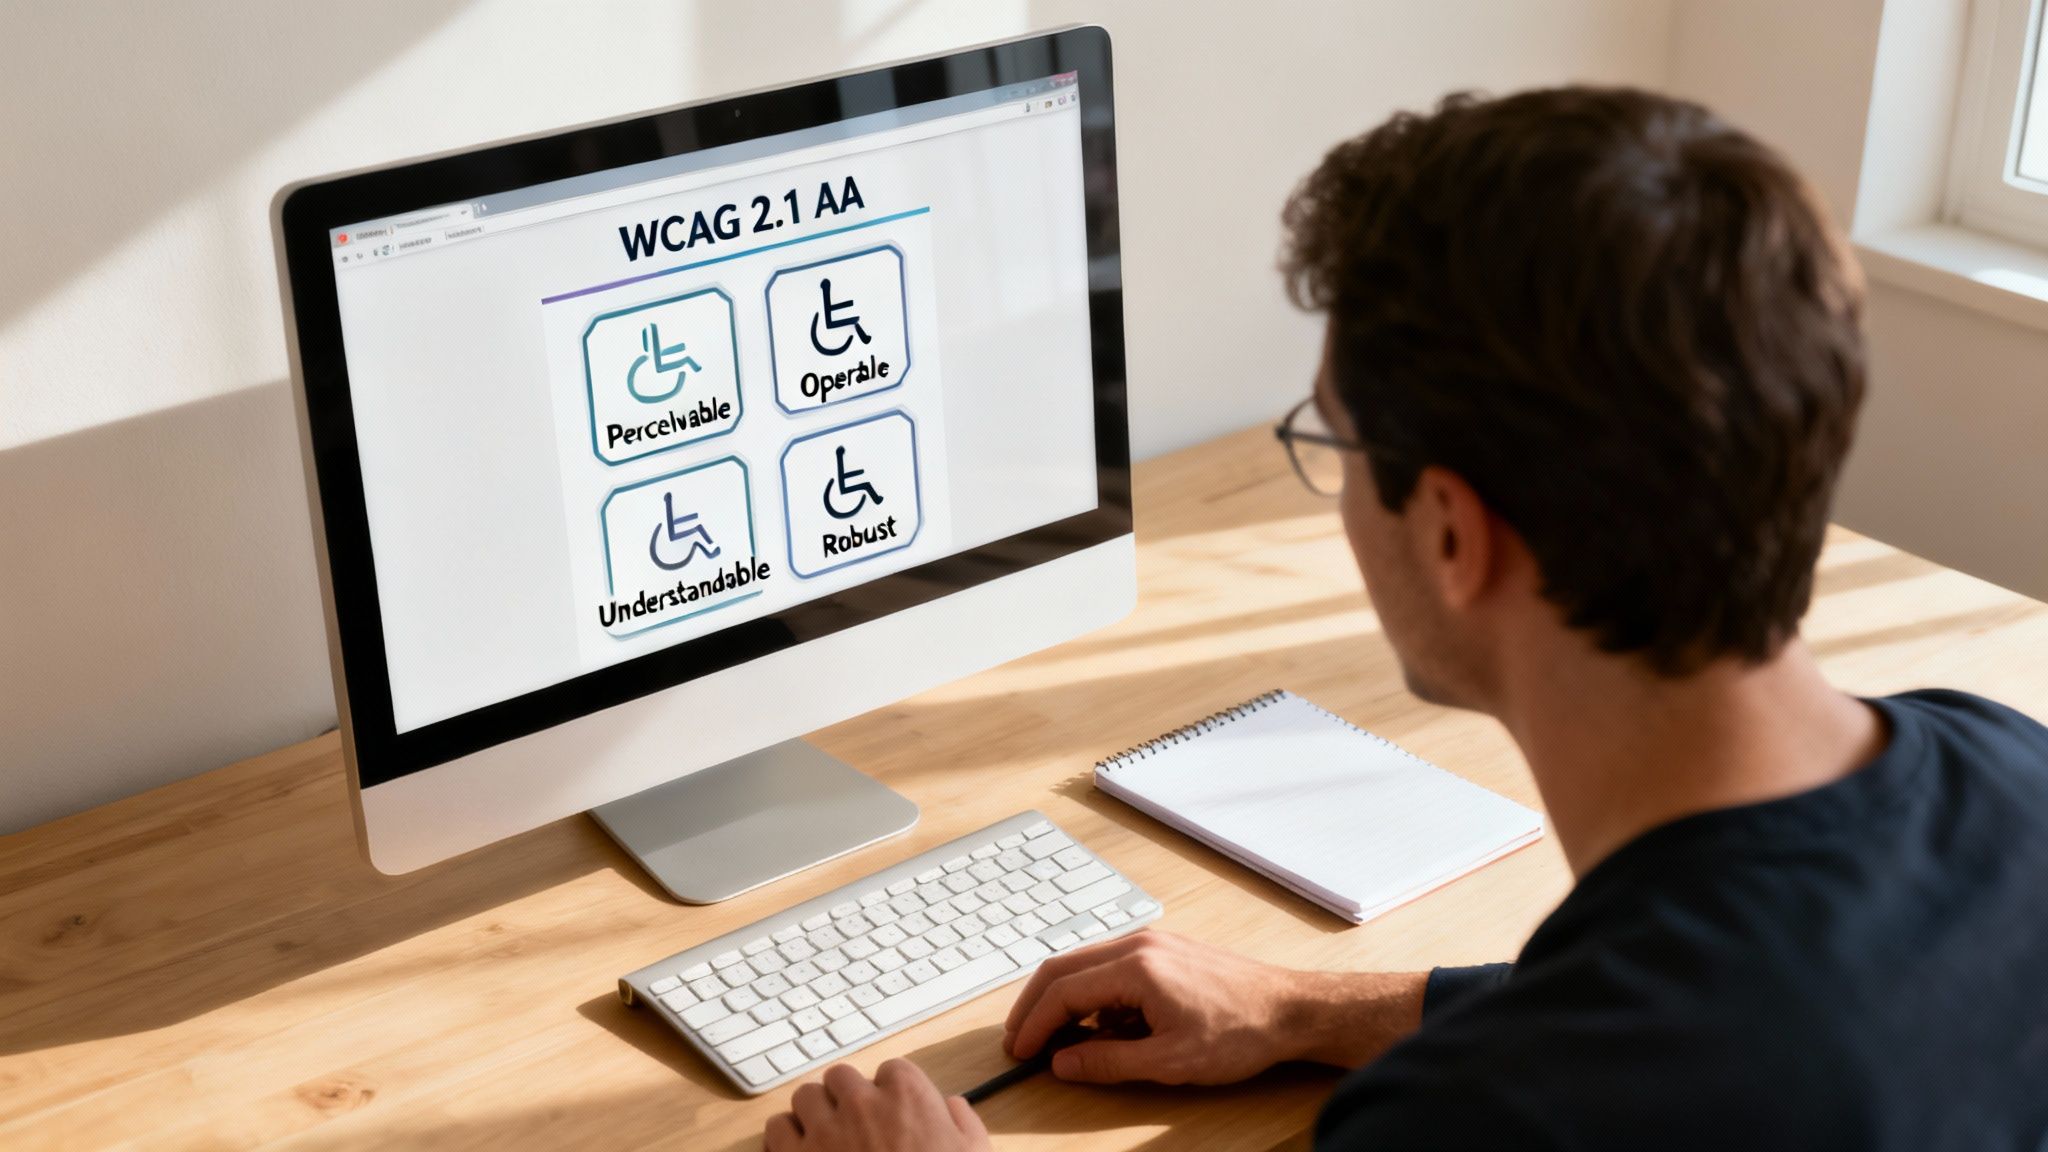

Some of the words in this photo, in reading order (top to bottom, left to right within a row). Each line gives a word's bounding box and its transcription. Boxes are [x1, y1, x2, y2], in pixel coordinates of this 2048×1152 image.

[618, 204, 741, 262] WCAG
[751, 188, 800, 234] 2.1
[814, 175, 865, 219] AA
[822, 514, 897, 558] Robust
[598, 556, 771, 628] Understandable
